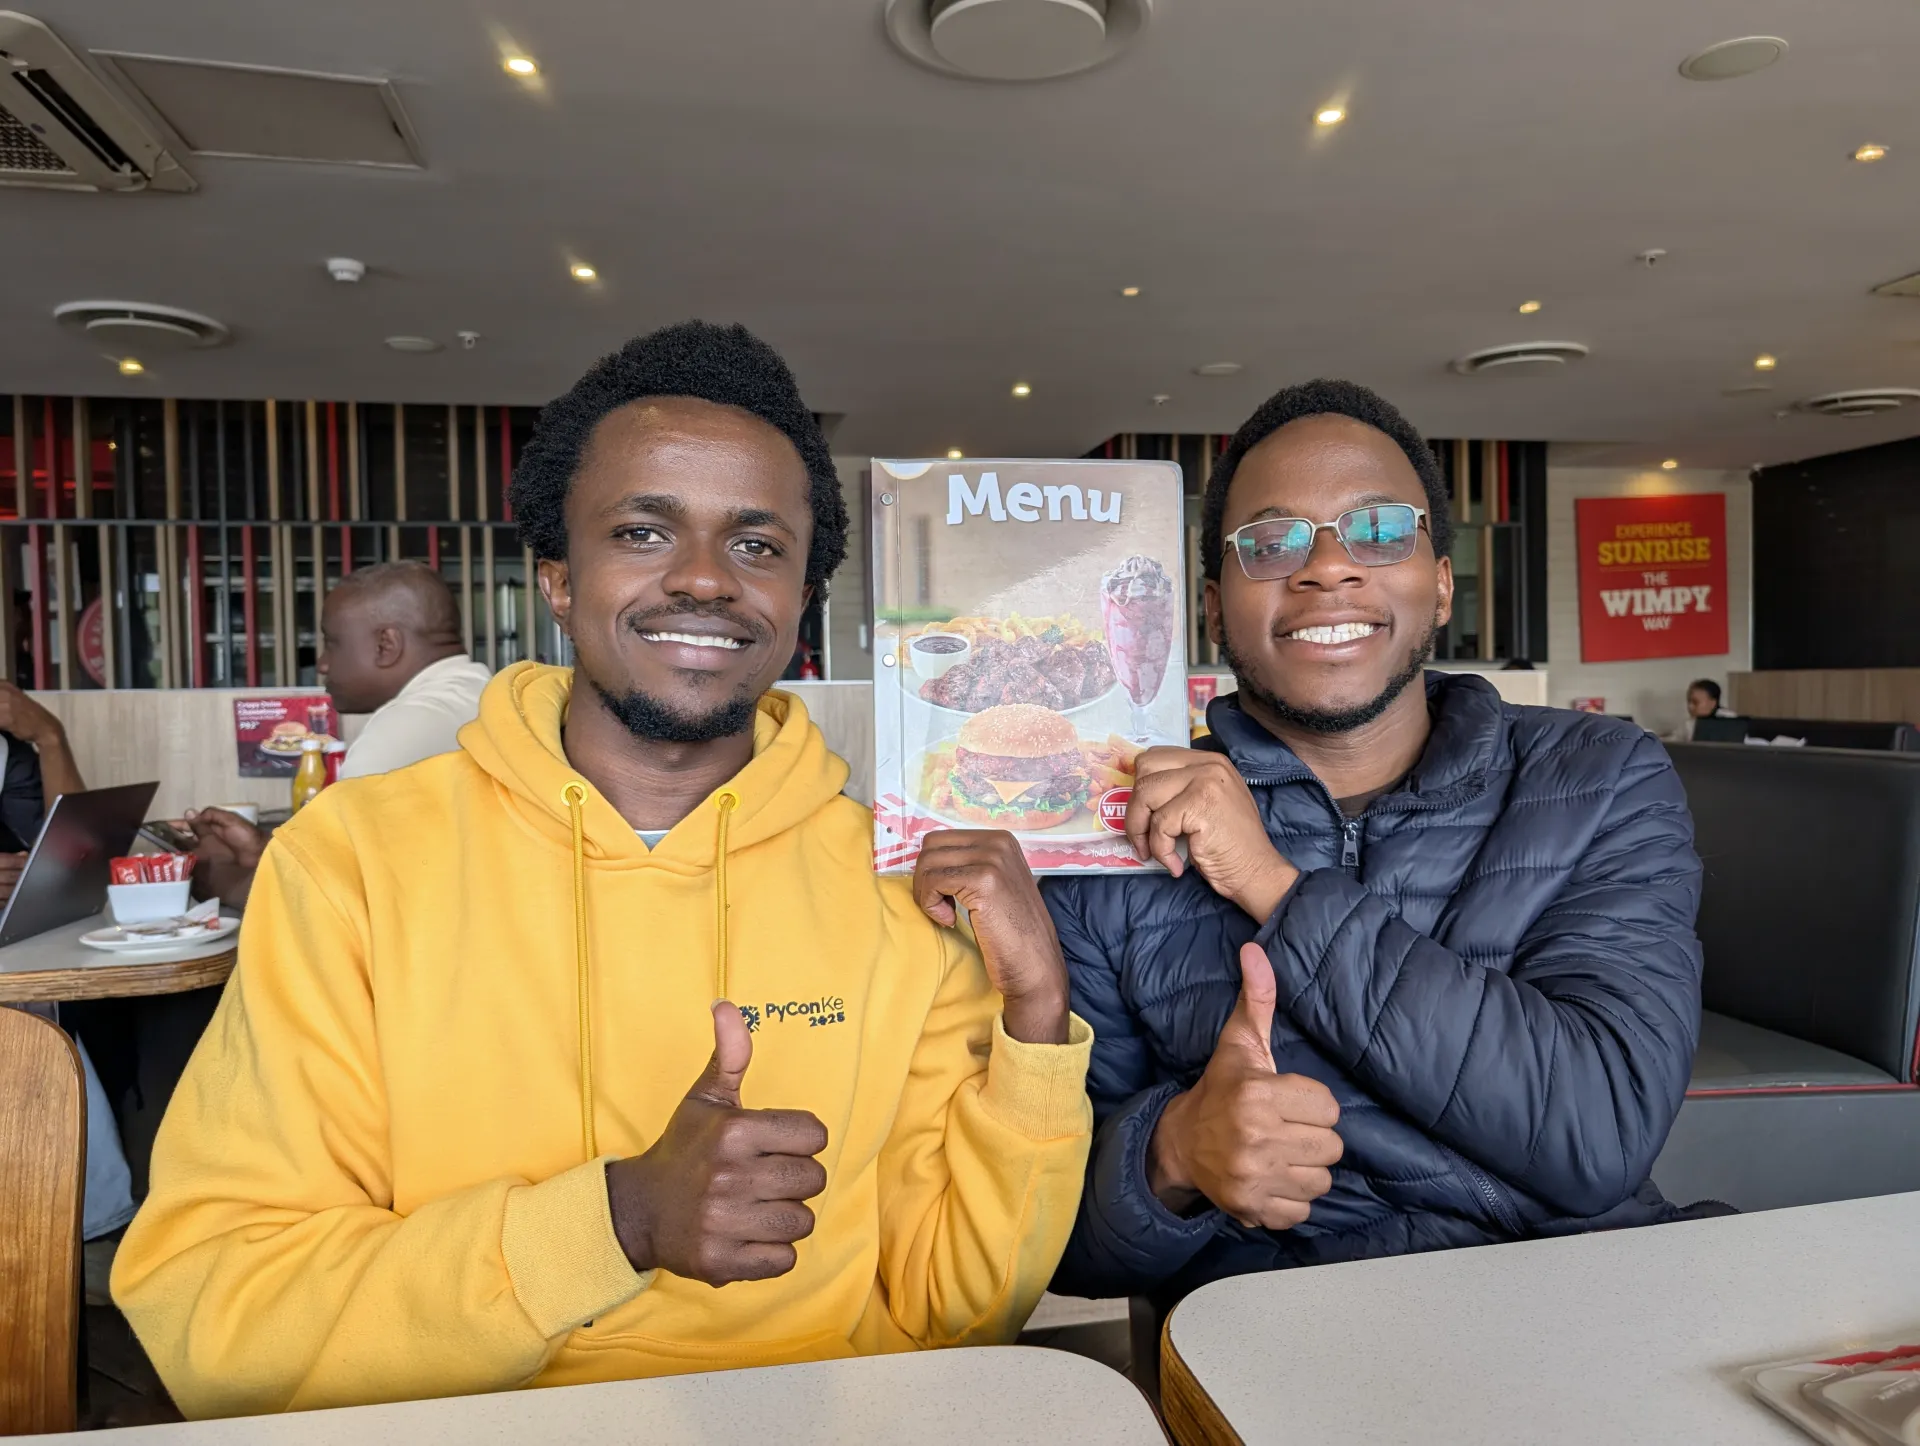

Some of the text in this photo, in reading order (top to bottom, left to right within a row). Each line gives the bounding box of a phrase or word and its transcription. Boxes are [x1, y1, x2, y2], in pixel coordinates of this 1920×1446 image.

[946, 471, 1122, 525] Menu
[1615, 522, 1692, 538] EXPERIENCE
[1598, 537, 1711, 565] SUNRISE
[1642, 571, 1669, 586] THE
[1600, 585, 1712, 617] WIMPY
[1642, 616, 1672, 631] WAY
[808, 1011, 846, 1027] 2025
